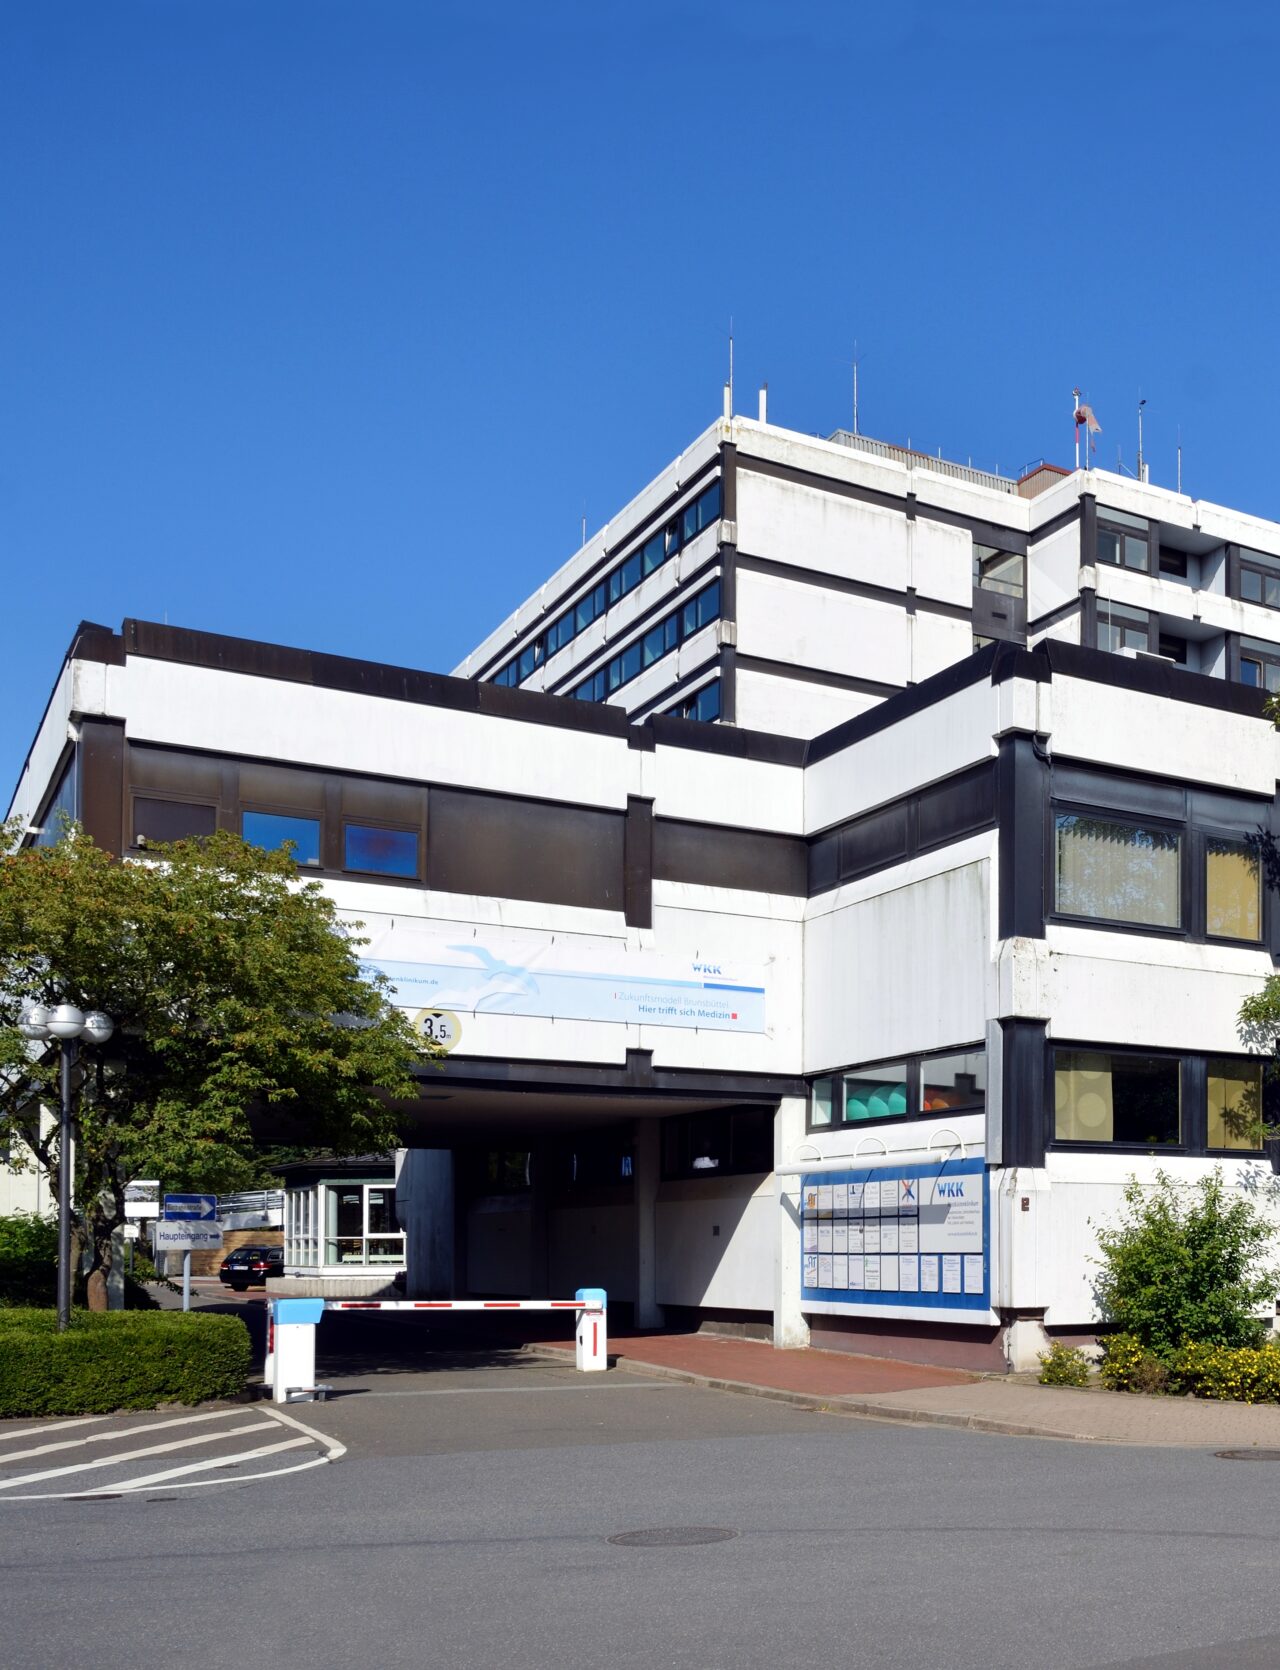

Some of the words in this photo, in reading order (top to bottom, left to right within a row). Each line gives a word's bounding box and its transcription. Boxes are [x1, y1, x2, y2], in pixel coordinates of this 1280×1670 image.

[692, 963, 722, 975] WKK
[638, 1005, 656, 1014] Hier
[658, 1007, 678, 1016] trifft
[679, 1008, 696, 1018] sich
[697, 1010, 731, 1020] Medizin
[937, 1181, 964, 1198] WKK
[160, 1232, 208, 1242] Haupteingang
